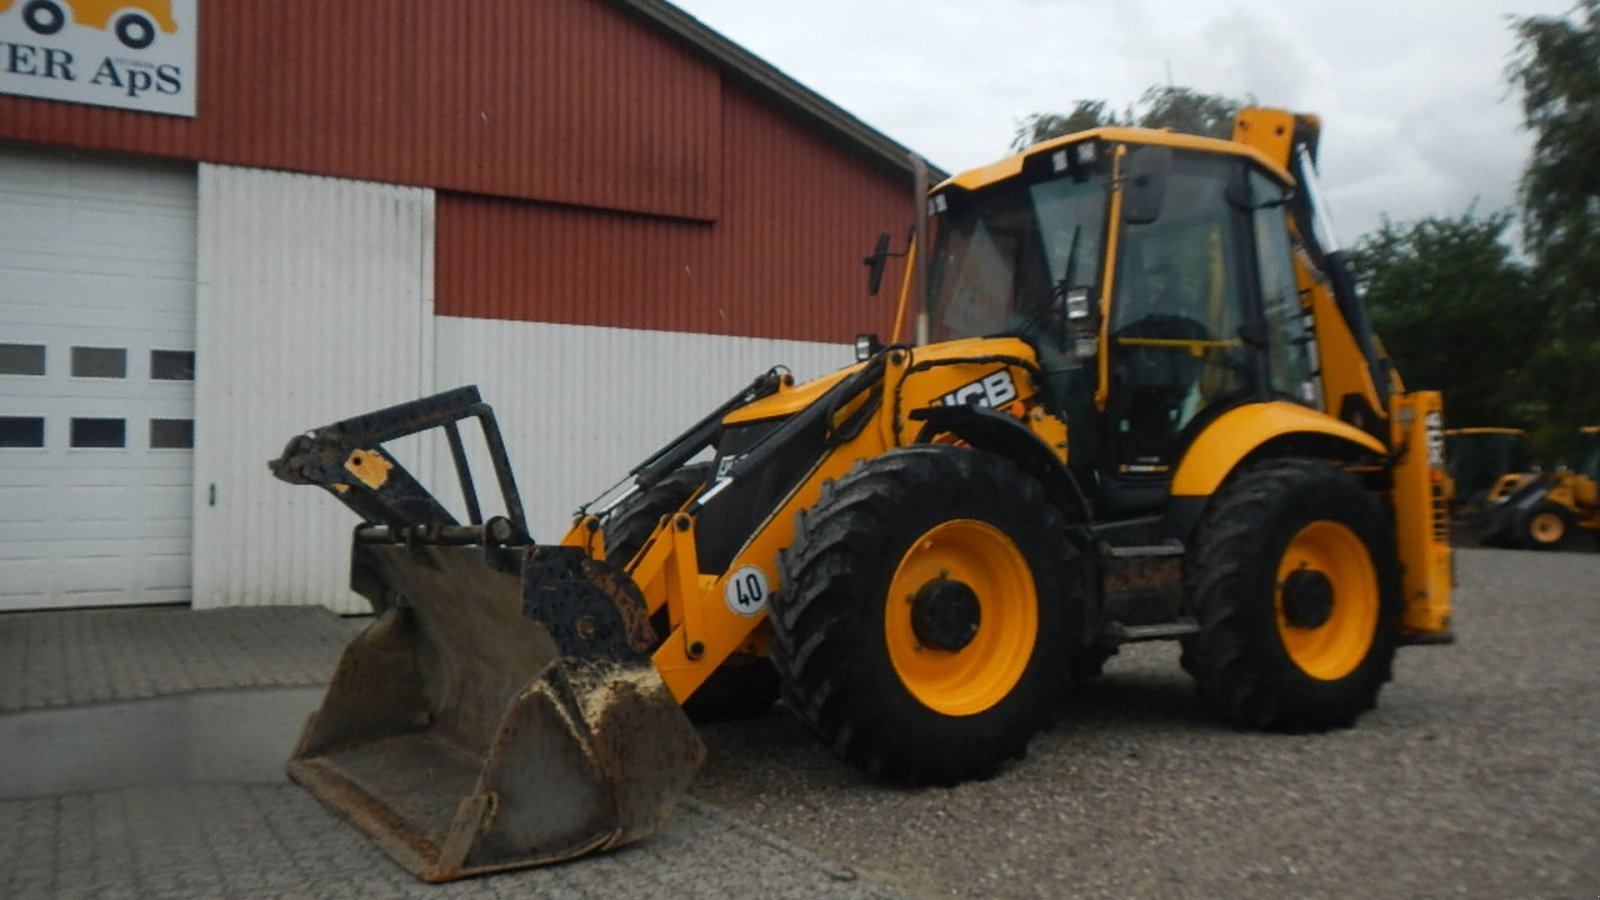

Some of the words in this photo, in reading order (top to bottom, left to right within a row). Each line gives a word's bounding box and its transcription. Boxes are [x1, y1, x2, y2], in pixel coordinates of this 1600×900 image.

[0, 42, 75, 81] ER
[90, 56, 182, 97] ApS
[735, 574, 762, 607] 40
